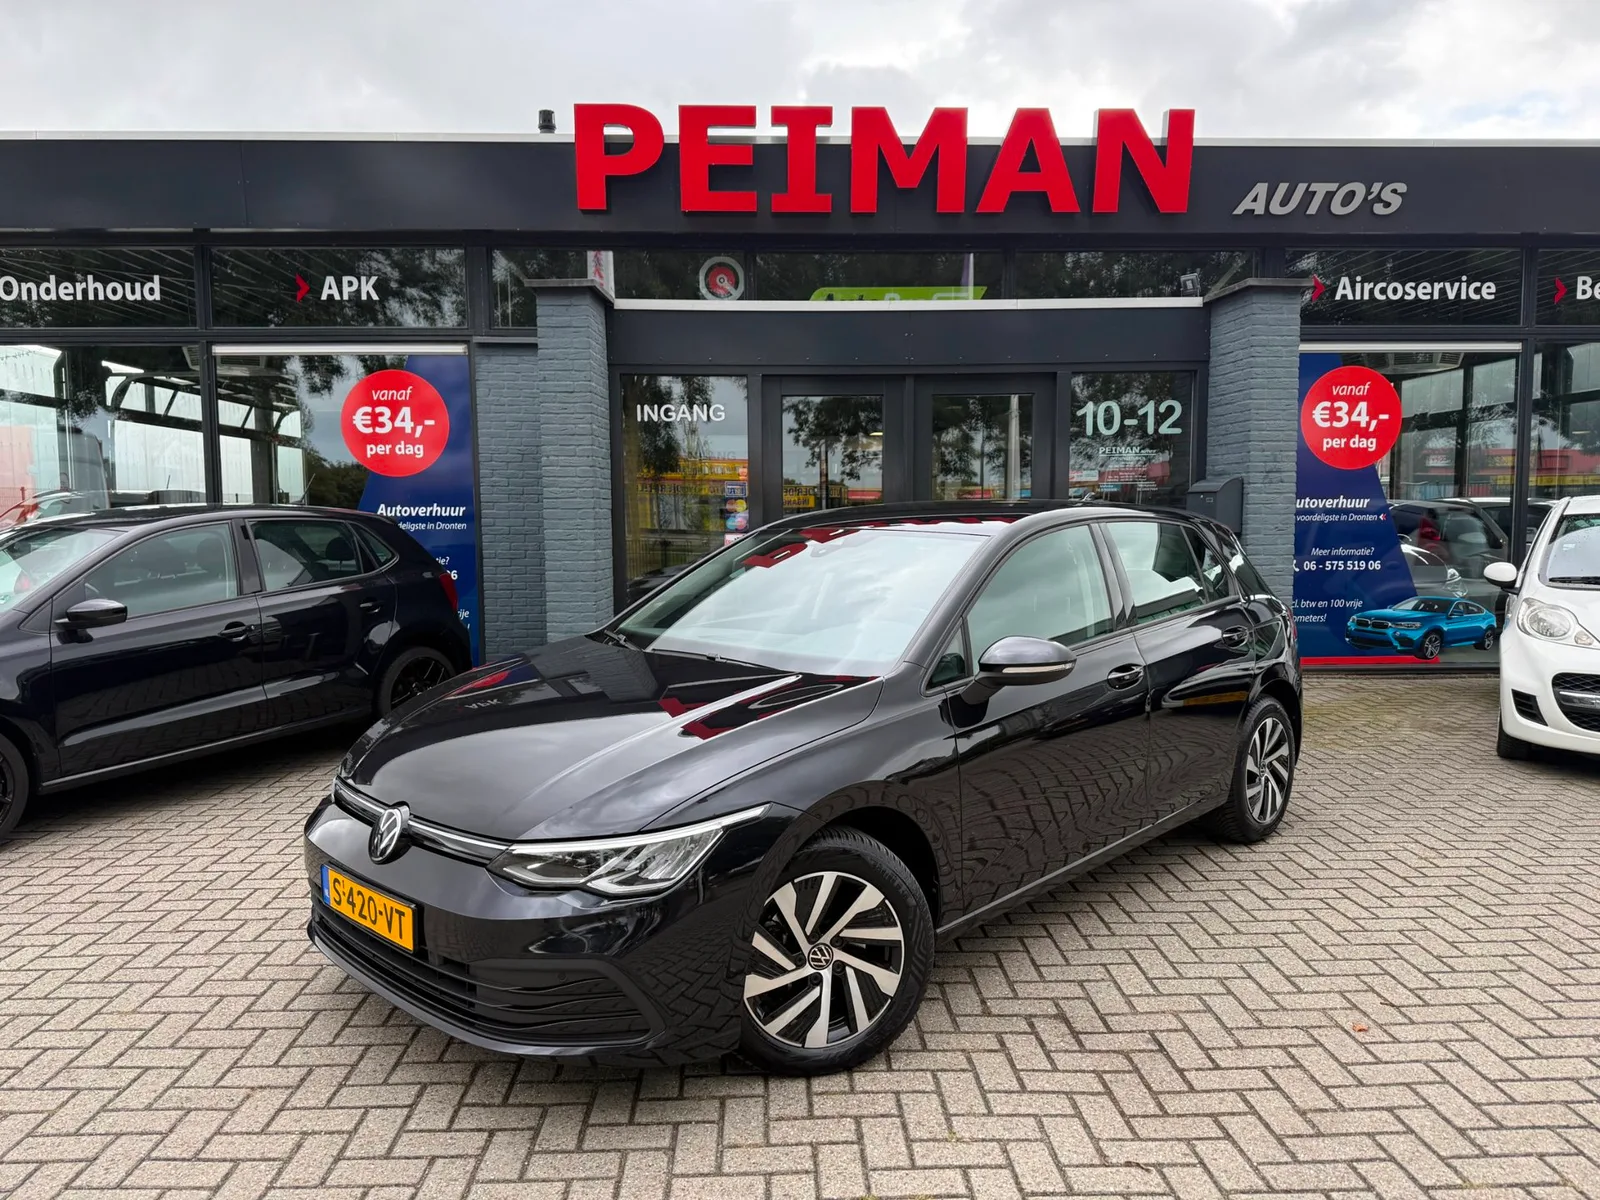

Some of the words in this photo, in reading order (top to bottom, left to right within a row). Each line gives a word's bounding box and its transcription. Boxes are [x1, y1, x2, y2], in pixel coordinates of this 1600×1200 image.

[574, 103, 1196, 214] PEIMAN
[1232, 181, 1408, 216] AUTO'S
[0, 274, 161, 302] Onderhoud
[320, 275, 380, 301] APK
[1335, 275, 1497, 301] Aircoservice
[371, 386, 413, 402] vanaf
[1331, 381, 1370, 397] vanaf
[352, 406, 436, 438] €34,-
[636, 403, 726, 423] INGANG
[1076, 400, 1183, 436] 10-12
[1312, 401, 1390, 433] €34,-
[365, 443, 392, 458] per
[395, 440, 425, 458] dag
[1099, 446, 1140, 454] PEIMAN
[1322, 437, 1347, 452] per
[1349, 434, 1377, 452] dag
[377, 503, 466, 517] Autoverhuur
[1296, 495, 1370, 509] utoverhuur
[427, 521, 434, 530] in
[436, 522, 467, 530] Dronten
[1296, 513, 1340, 523] voordeligste
[1340, 513, 1348, 521] in
[1349, 513, 1378, 521] Dronten
[1311, 547, 1331, 556] Meer
[1331, 546, 1374, 556] informatie?
[1303, 561, 1317, 571] 06
[1325, 561, 1344, 571] 575
[1346, 561, 1366, 571] 519
[1368, 561, 1381, 571] 06
[1300, 599, 1317, 608] btw
[1318, 600, 1328, 608] en
[1330, 599, 1344, 608] 100
[1346, 599, 1363, 610] vrije
[332, 877, 406, 940] S-420-VT
